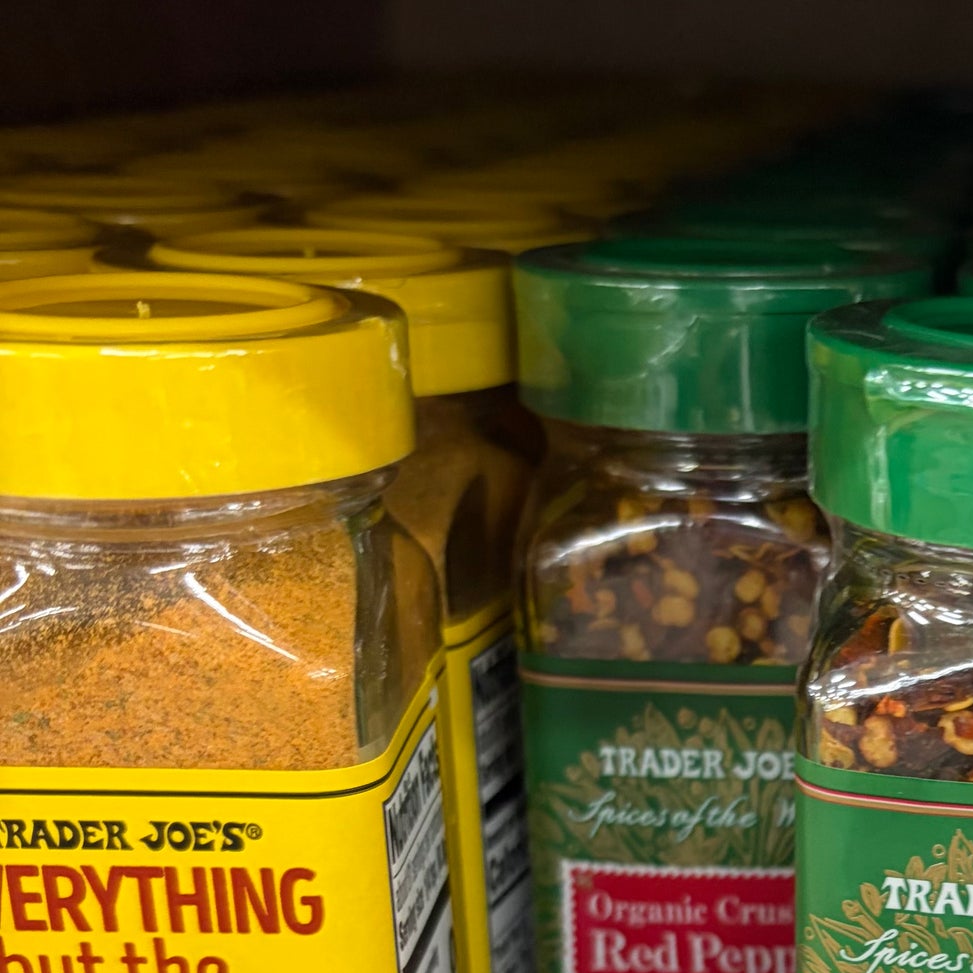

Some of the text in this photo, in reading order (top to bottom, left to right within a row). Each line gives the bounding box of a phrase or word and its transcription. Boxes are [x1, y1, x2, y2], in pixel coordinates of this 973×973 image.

[599, 746, 795, 780] TRADER JOE
[0, 819, 128, 851] RADER
[568, 792, 666, 840] Spices
[670, 797, 722, 843] of
[707, 796, 757, 828] the
[0, 863, 325, 936] ERYTHING
[589, 892, 794, 927] Organic Crus
